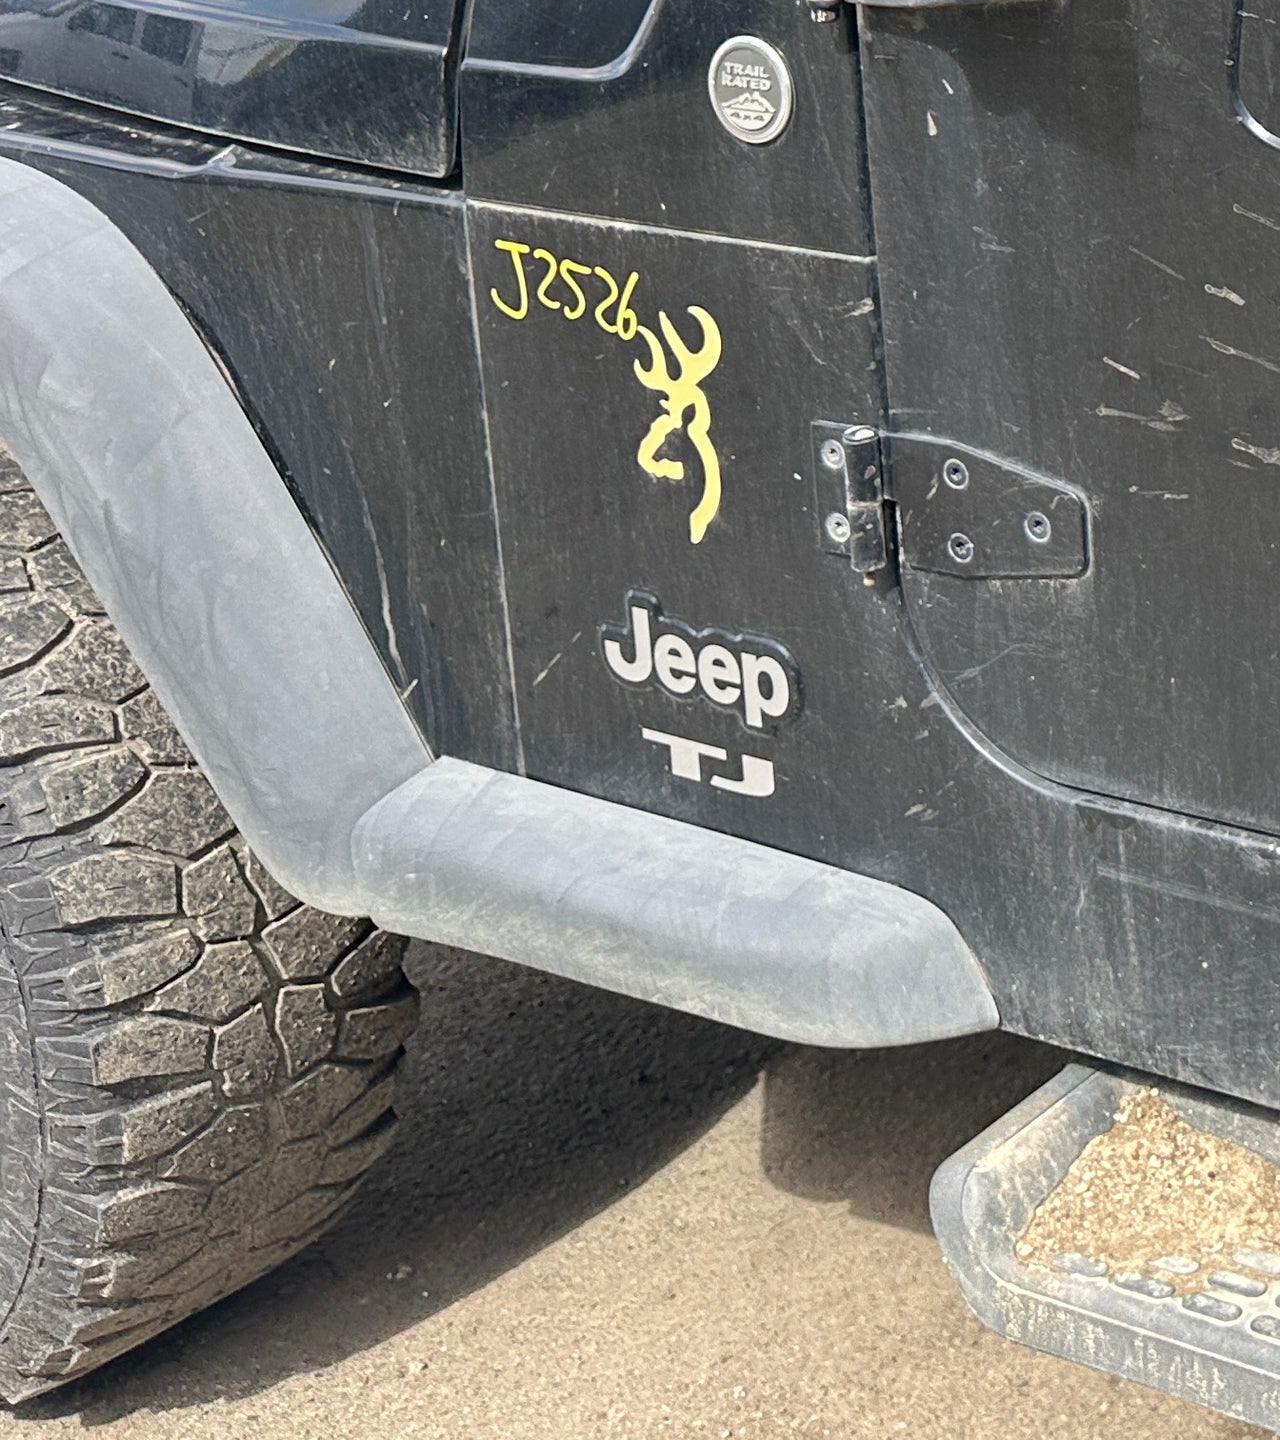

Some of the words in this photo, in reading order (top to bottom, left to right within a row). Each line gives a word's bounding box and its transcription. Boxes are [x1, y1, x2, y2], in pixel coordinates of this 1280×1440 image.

[721, 71, 772, 91] RATED
[724, 61, 770, 78] TRAIL
[491, 240, 638, 339] J2526
[604, 606, 789, 728] Jeep
[641, 727, 775, 797] TJ
